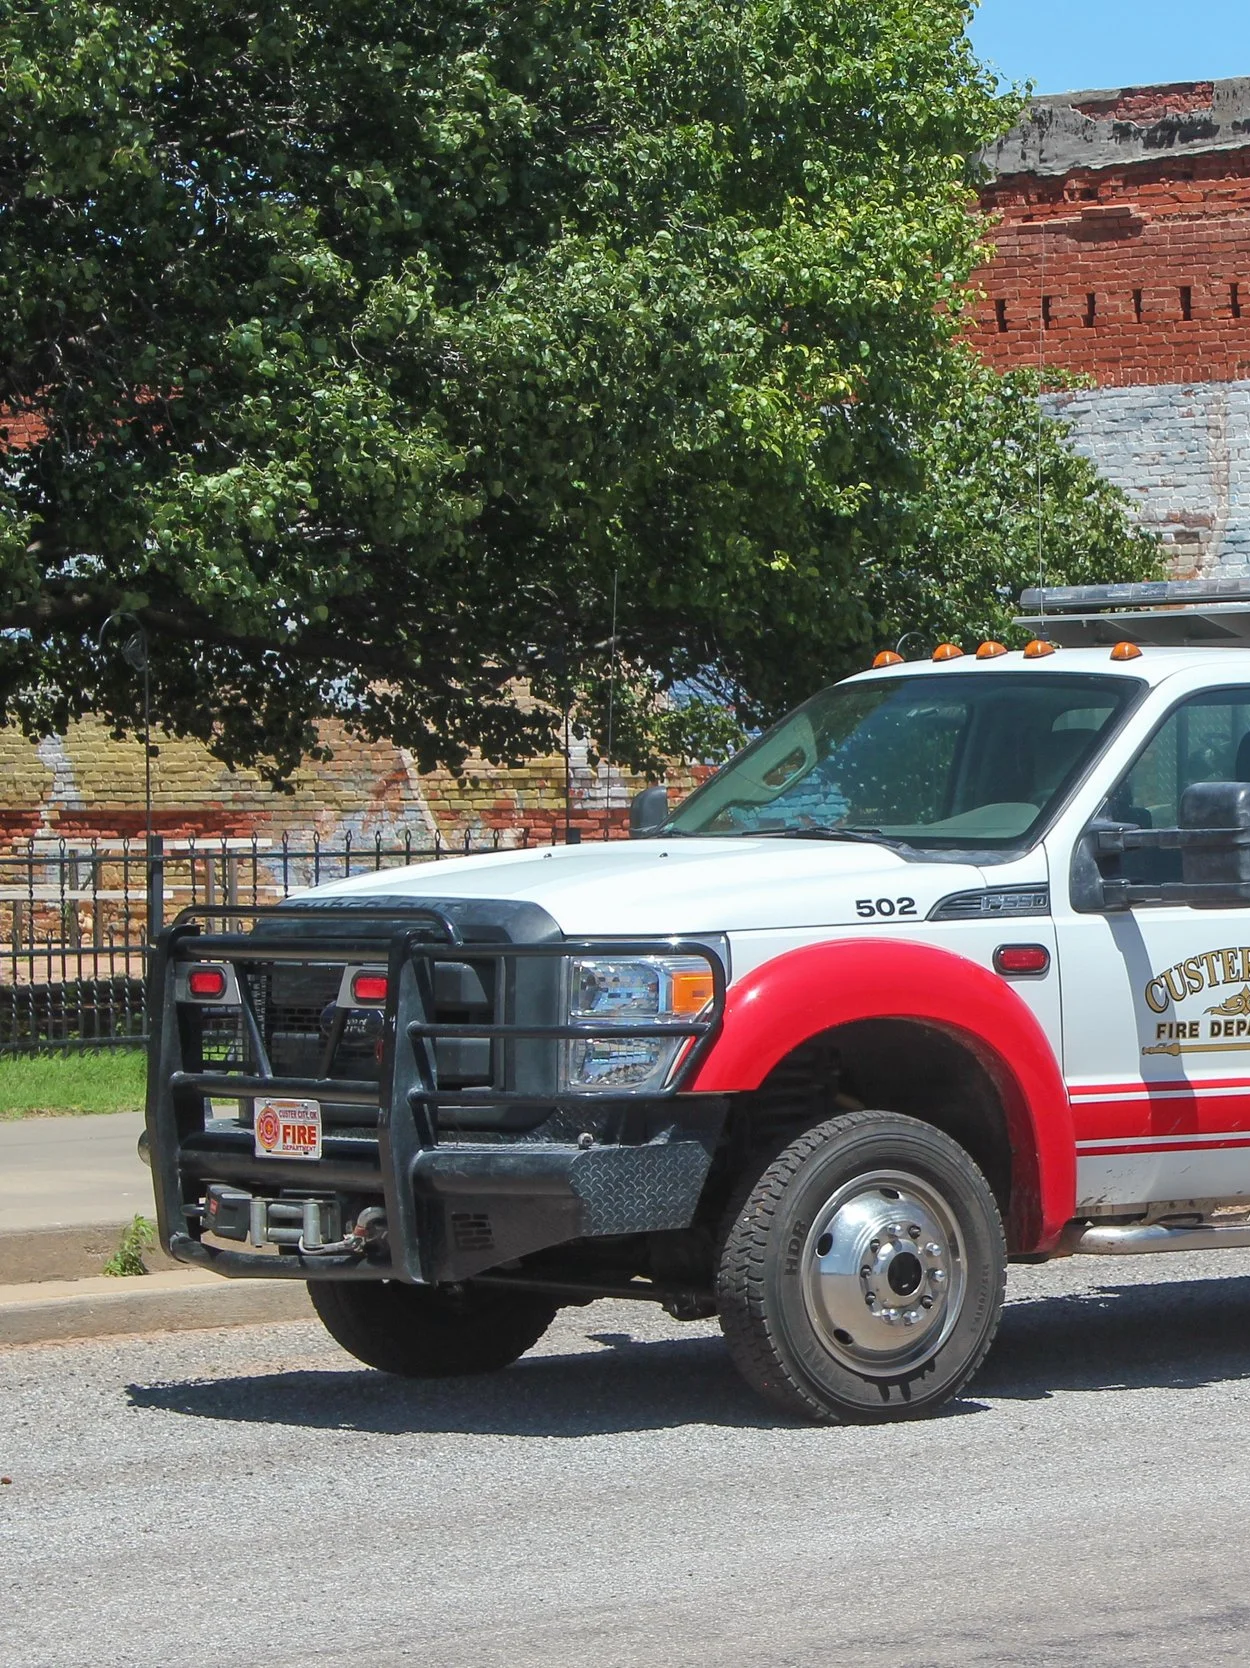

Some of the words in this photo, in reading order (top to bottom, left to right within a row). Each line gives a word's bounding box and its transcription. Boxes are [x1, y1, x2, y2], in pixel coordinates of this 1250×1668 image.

[856, 897, 918, 917] 502
[1156, 1020, 1200, 1040] FIRE
[279, 1110, 297, 1119] CUSTER
[283, 1124, 316, 1145] FIRE
[784, 1220, 806, 1275] HDR
